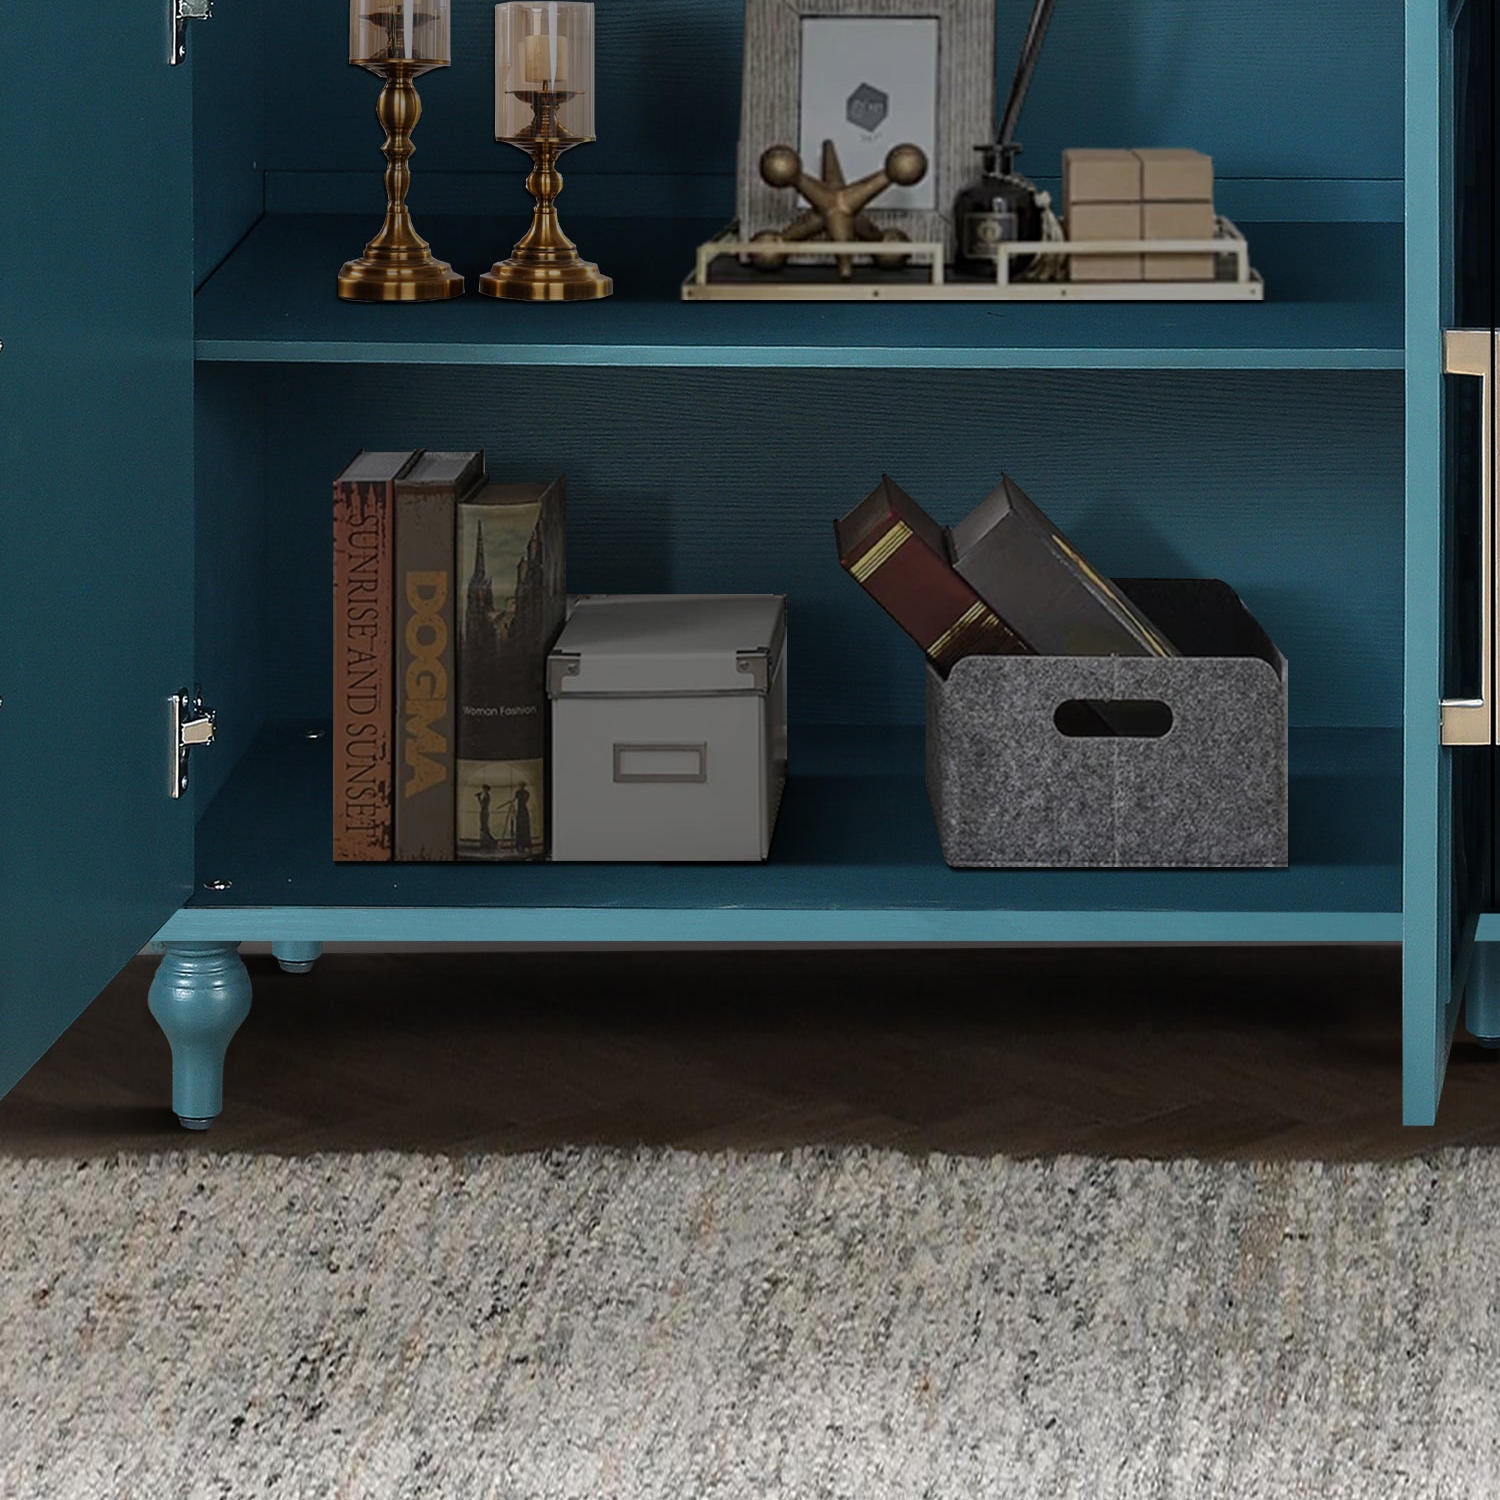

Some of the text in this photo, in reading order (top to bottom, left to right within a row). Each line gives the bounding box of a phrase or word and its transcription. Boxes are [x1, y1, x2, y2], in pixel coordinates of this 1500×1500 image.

[344, 510, 380, 839] SUNRISE AND SUNSET
[405, 570, 448, 799] DOGMA
[462, 705, 537, 716] Woman Fashion
